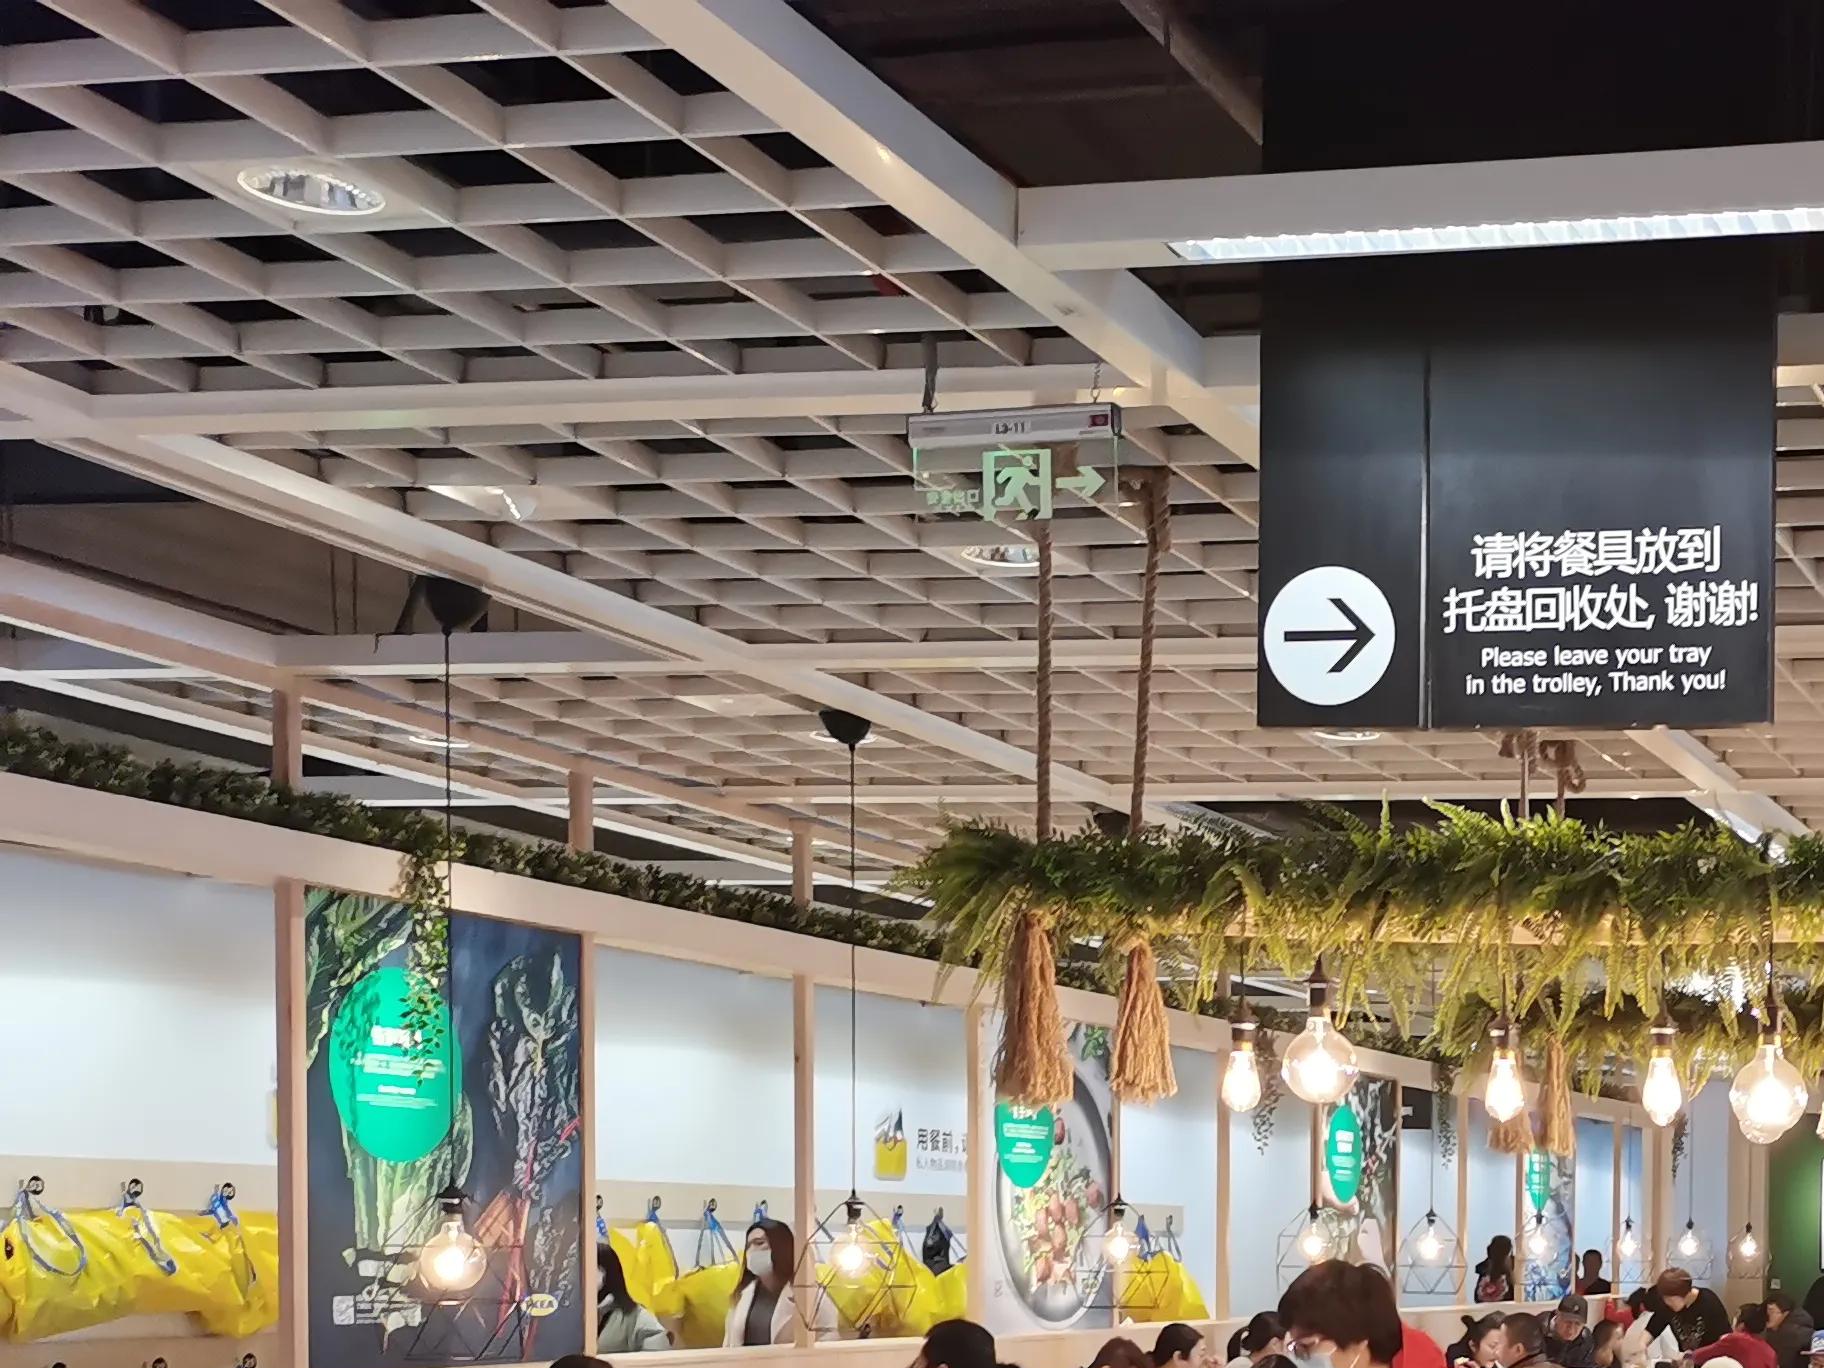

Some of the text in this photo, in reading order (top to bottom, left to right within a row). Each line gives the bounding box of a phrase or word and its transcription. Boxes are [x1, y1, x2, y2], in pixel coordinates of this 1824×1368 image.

[1470, 525, 1721, 579] 请将餐具放到
[1481, 643, 1713, 669] Please leave your tray
[1466, 669, 1726, 697] in the trolley, Thank you!
